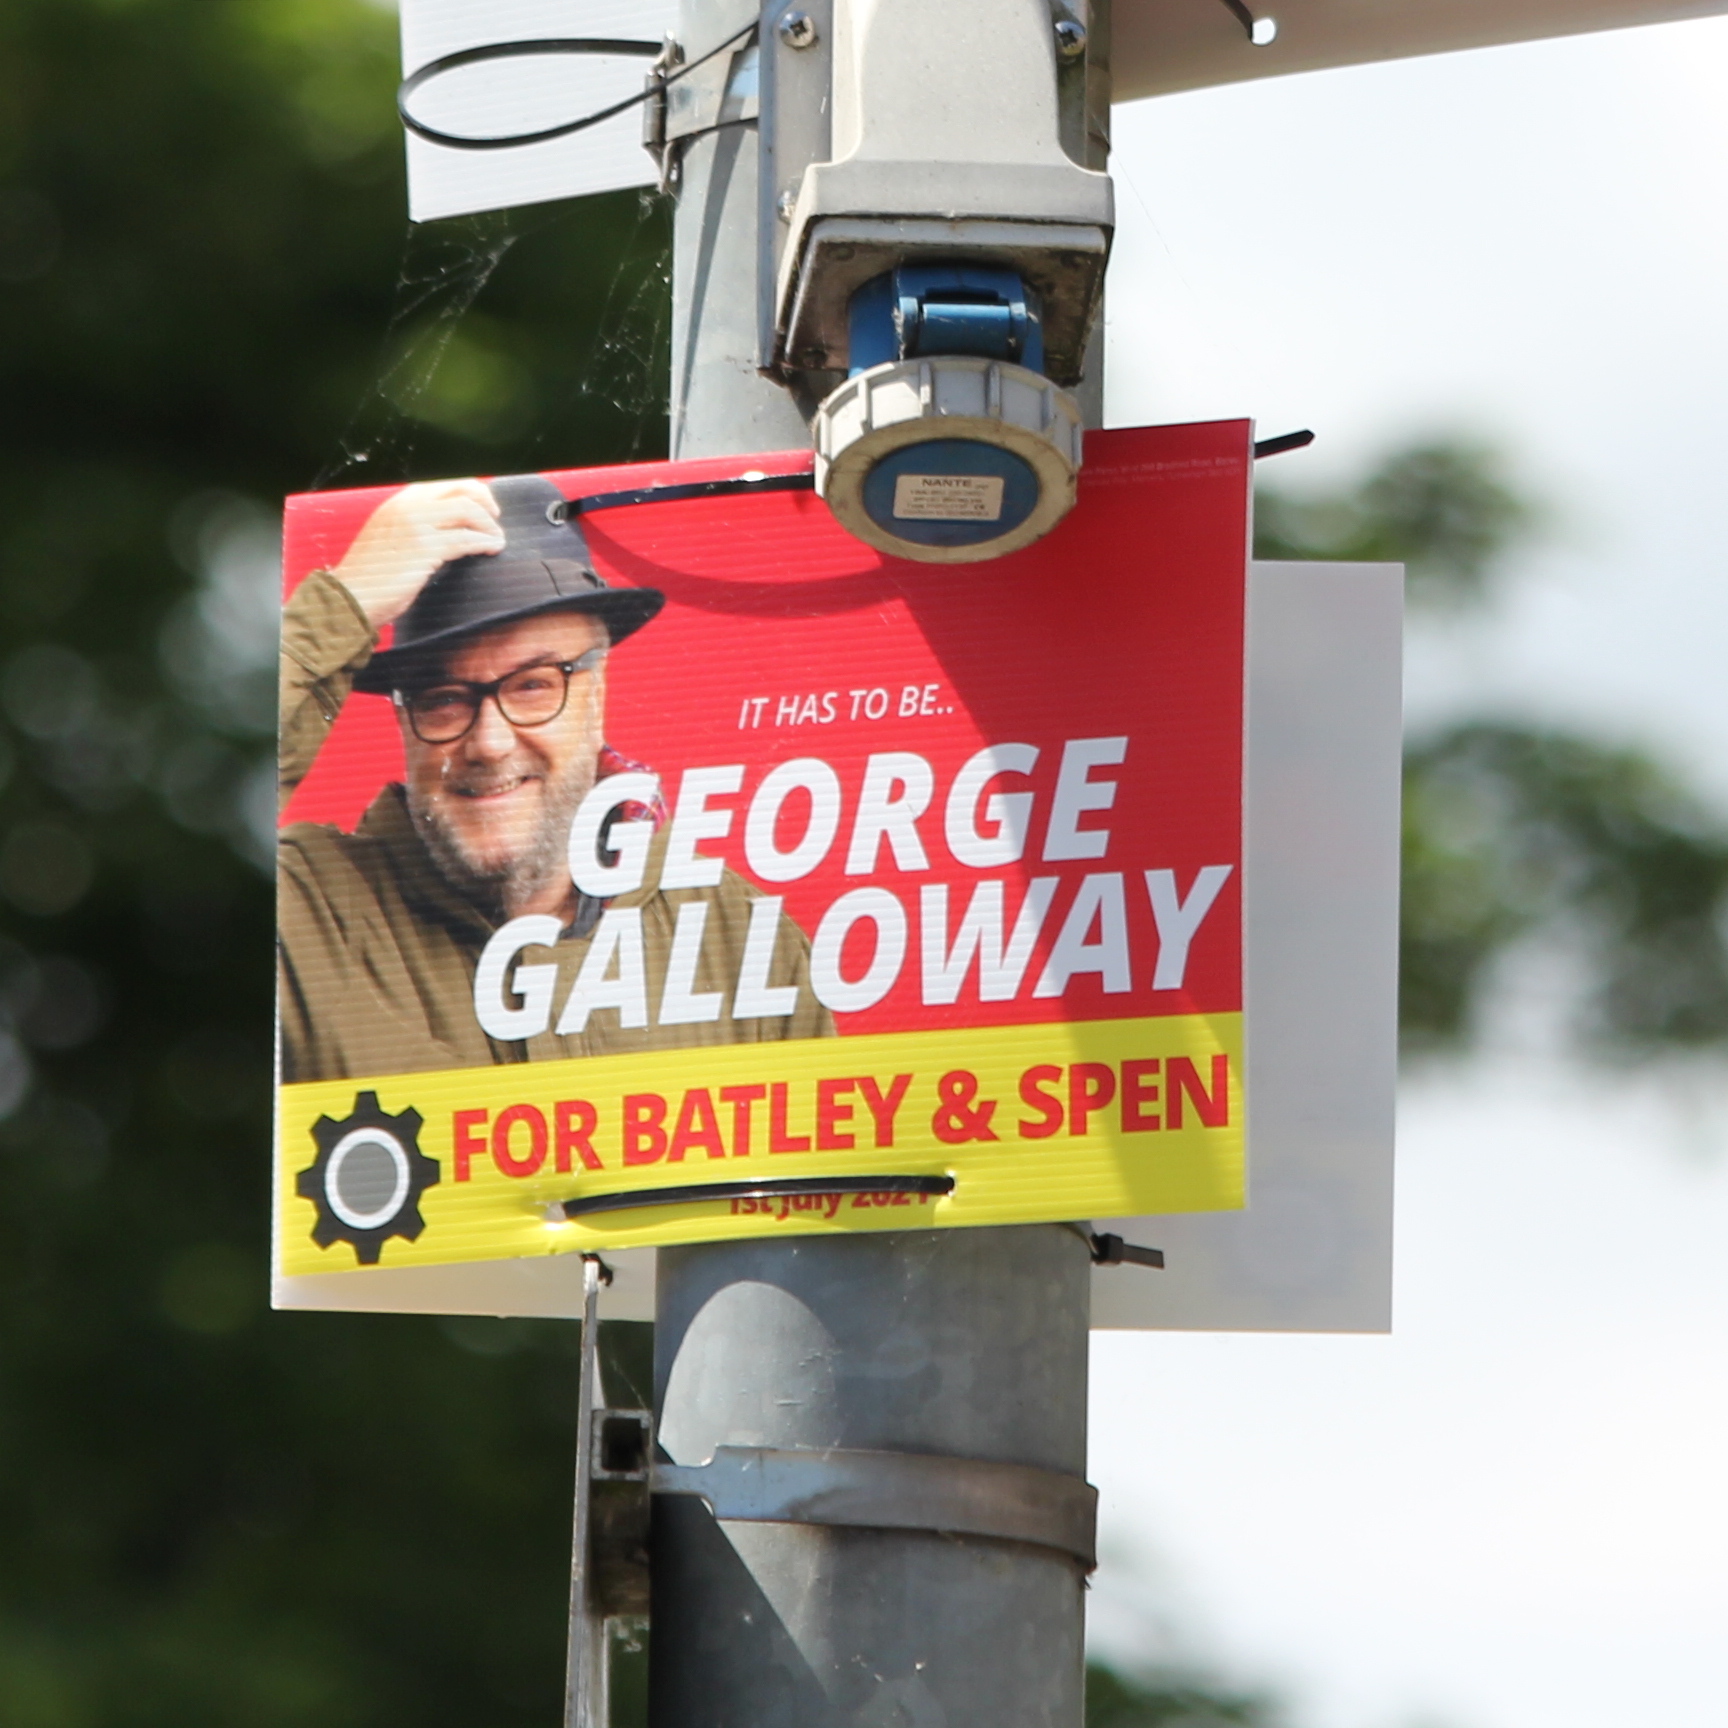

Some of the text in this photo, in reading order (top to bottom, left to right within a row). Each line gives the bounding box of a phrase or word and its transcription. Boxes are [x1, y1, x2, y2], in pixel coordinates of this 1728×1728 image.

[739, 684, 955, 729] IT HAS TO BE..
[566, 735, 1129, 899] GEORGE
[472, 864, 1232, 1041] GALLOWAY
[453, 1054, 1230, 1182] FOR BATLEY & SPEN
